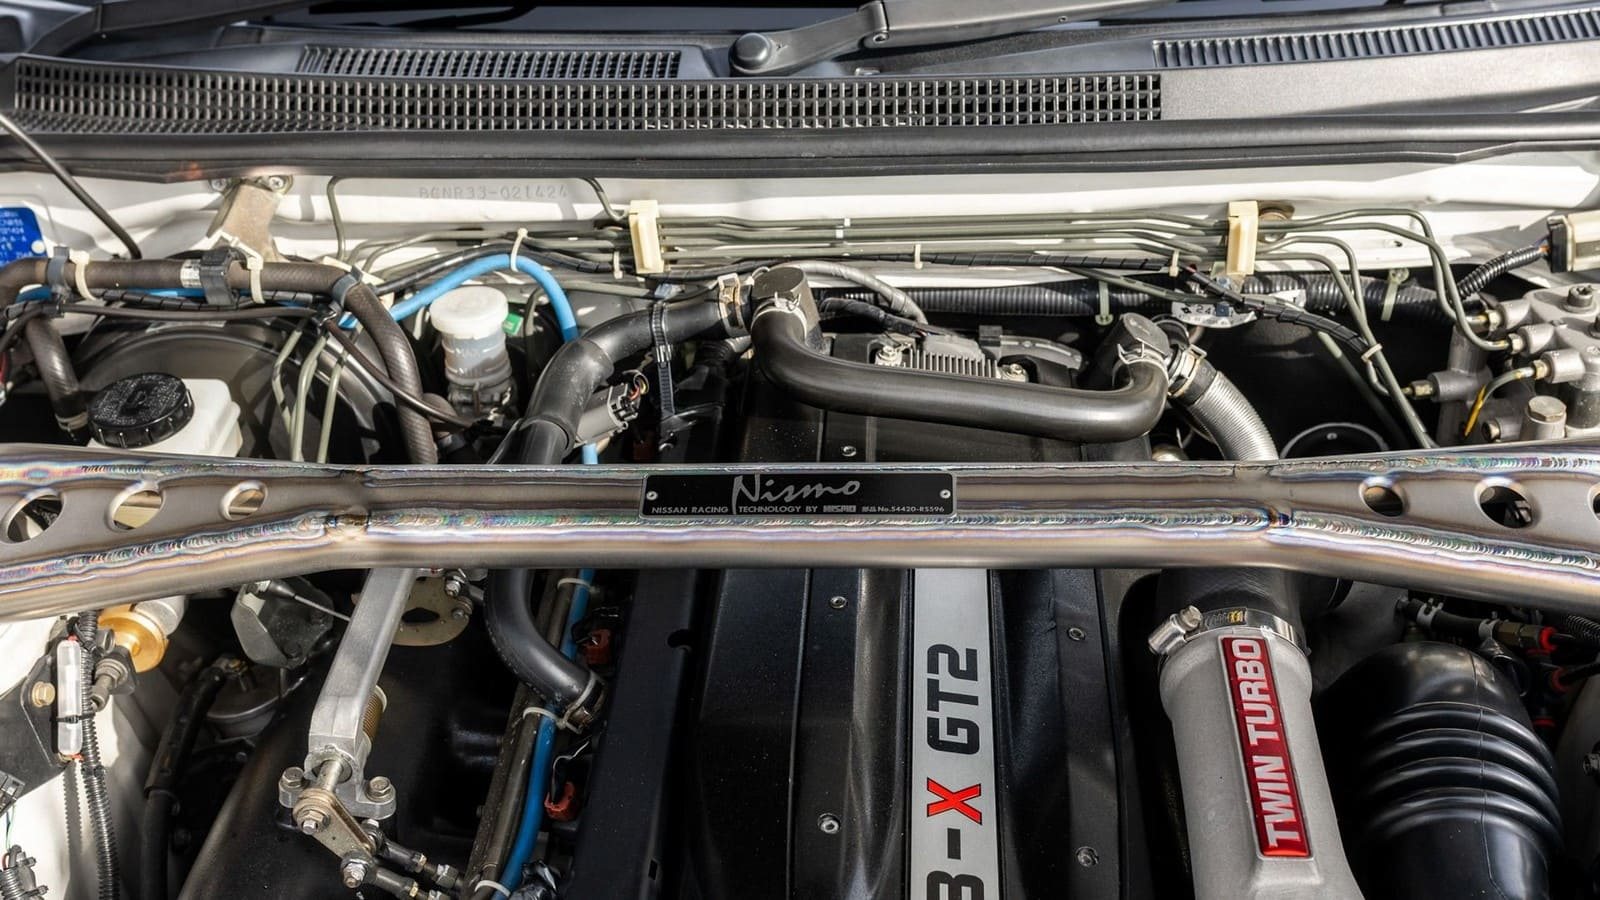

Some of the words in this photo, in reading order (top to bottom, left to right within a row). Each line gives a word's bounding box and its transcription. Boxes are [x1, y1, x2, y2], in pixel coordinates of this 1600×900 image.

[651, 506, 688, 514] NISSAN
[738, 505, 801, 513] TECHNOLOGY
[805, 505, 818, 513] BY
[732, 474, 861, 515] Nismo
[926, 643, 980, 756] GT2
[1232, 639, 1280, 746] TURBO
[1252, 755, 1301, 848] TWIN
